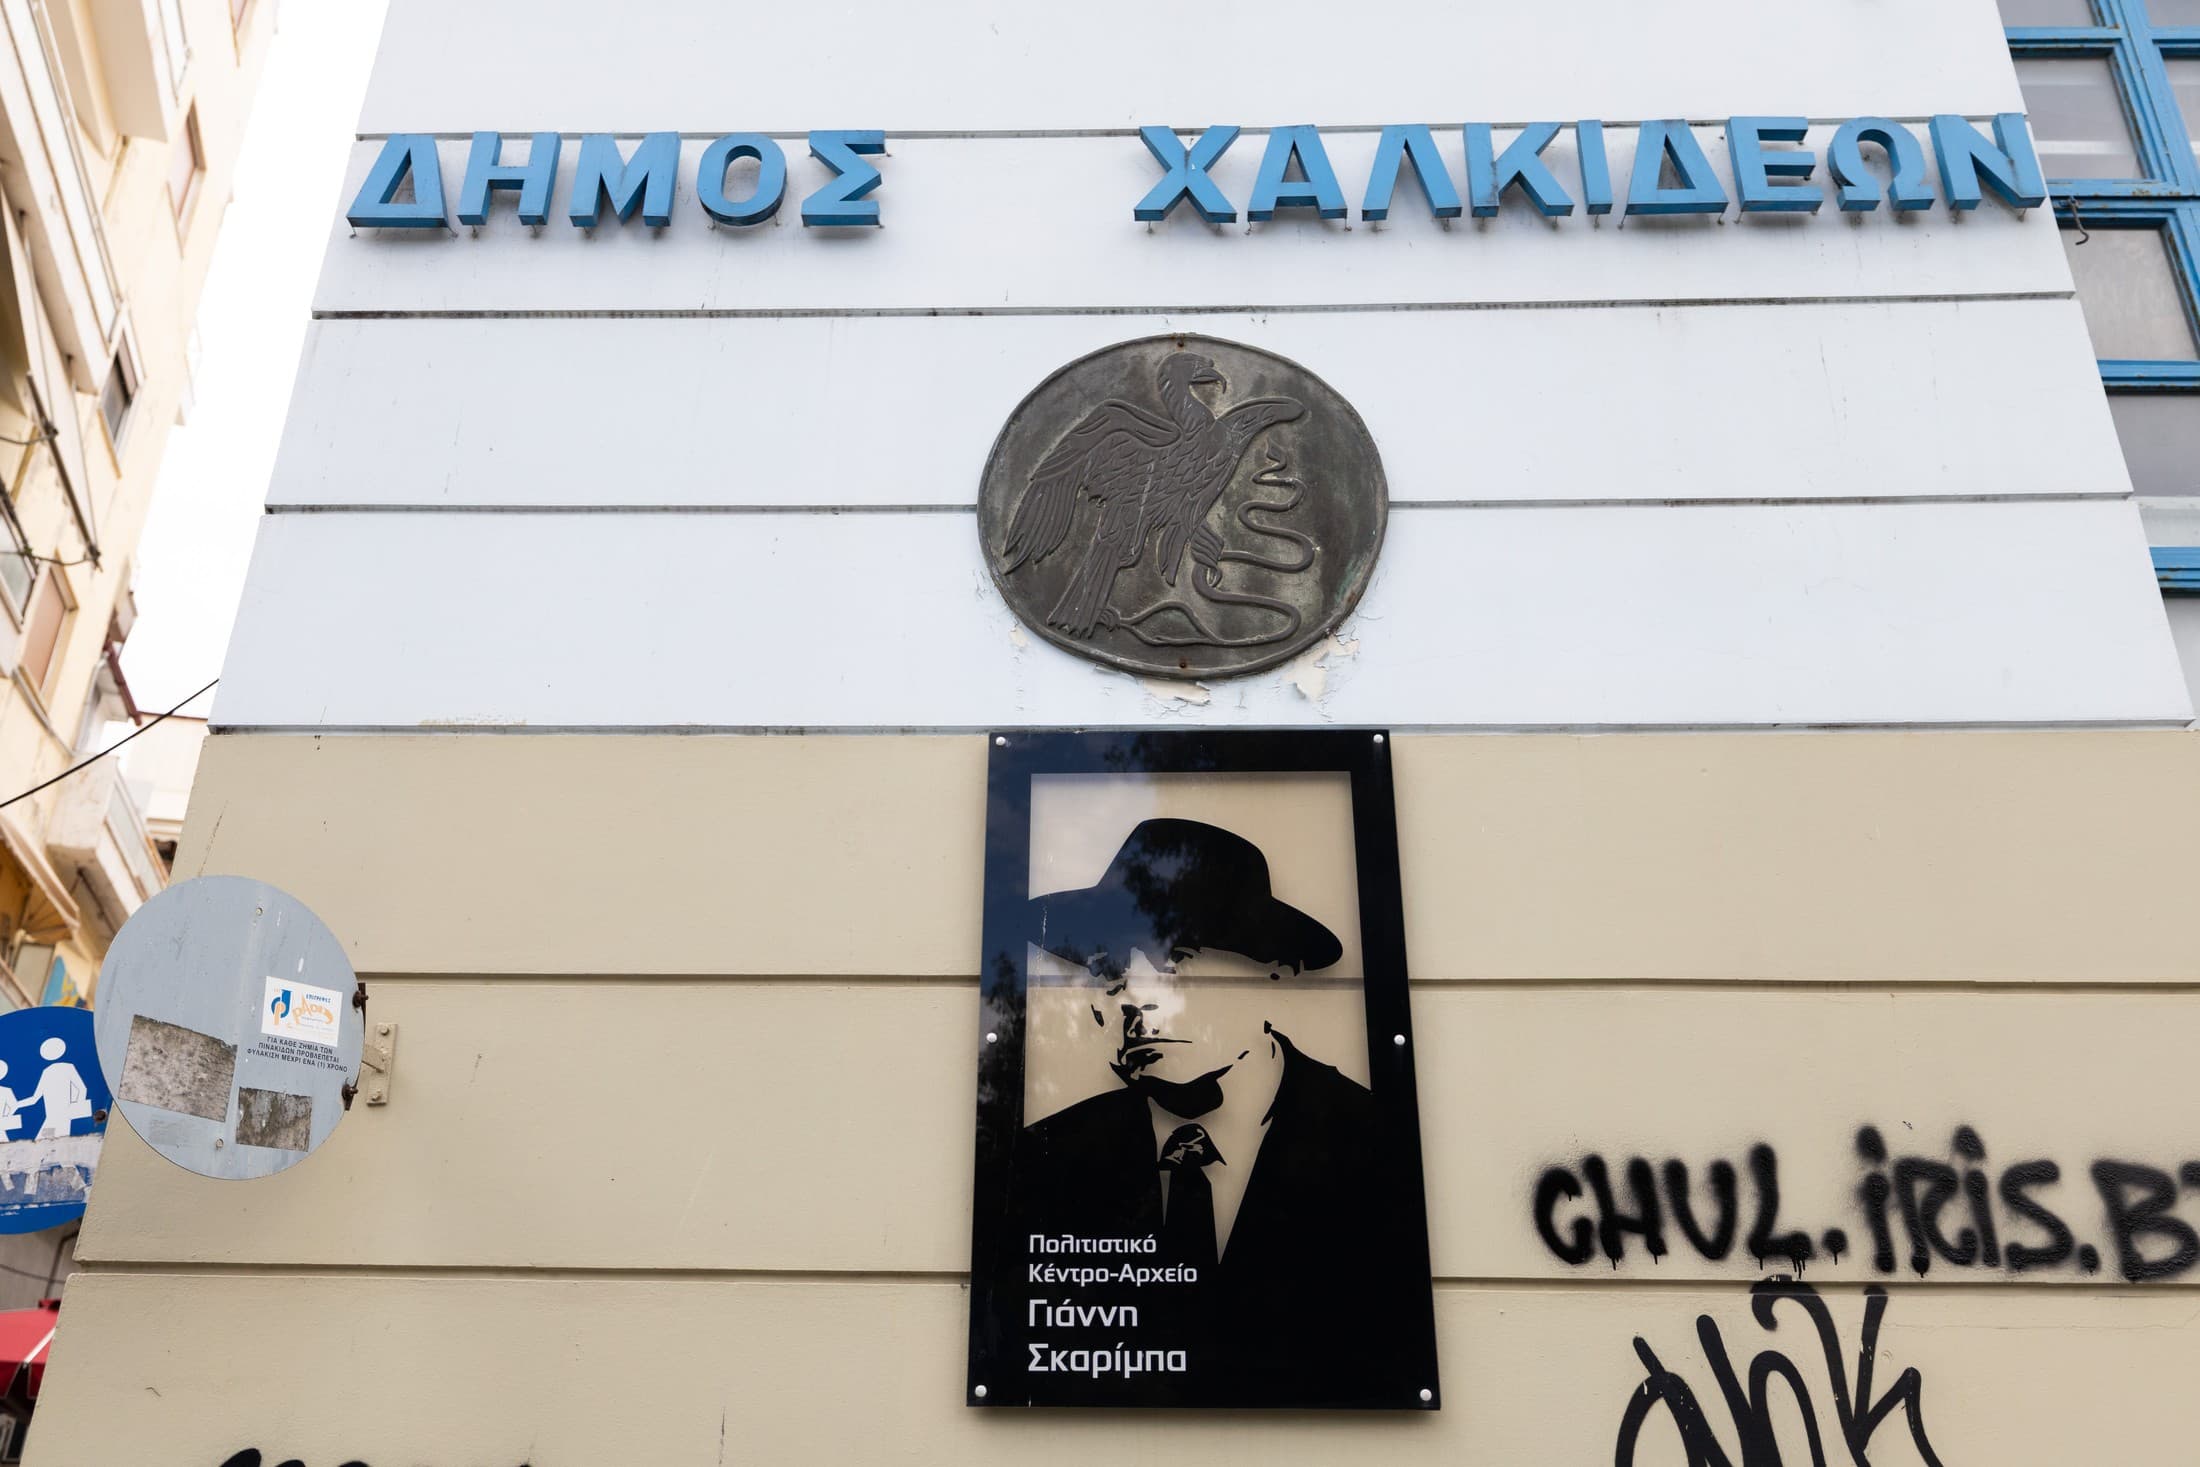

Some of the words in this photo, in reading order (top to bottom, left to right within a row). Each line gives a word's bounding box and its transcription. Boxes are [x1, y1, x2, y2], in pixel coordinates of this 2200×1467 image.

[346, 130, 886, 228] ΔΗΜΟΣ
[1133, 112, 2046, 221] ΧΑΛΚΙΔΕΩΝ
[258, 1042, 295, 1055] ΠΙΝΑΚΙΔΩΝ
[296, 1049, 340, 1063] ΠΡΟΒΛΕΠΕΤΑΙ
[266, 1036, 278, 1044] ΓΙΑ
[280, 1038, 297, 1048] ΚΑΘΕ
[299, 1042, 318, 1052] ΖΗΜΙΑ
[320, 1047, 333, 1055] ΤΩΝ
[247, 1048, 280, 1060] ΦΥΛΑΚΙΣΗ
[281, 1054, 301, 1064] ΜΕΧΡΙ
[303, 1058, 316, 1066] ΕΝΑ
[317, 1060, 326, 1069] (1)
[327, 1062, 348, 1073] ΧΡΟΝΟ
[1029, 1233, 1157, 1253] Πολιτιστικό
[1028, 1263, 1198, 1287] Κέντρο-Αρχείο
[1029, 1298, 1138, 1327] Γιάννη
[1028, 1341, 1187, 1379] Σκαρίμπα
